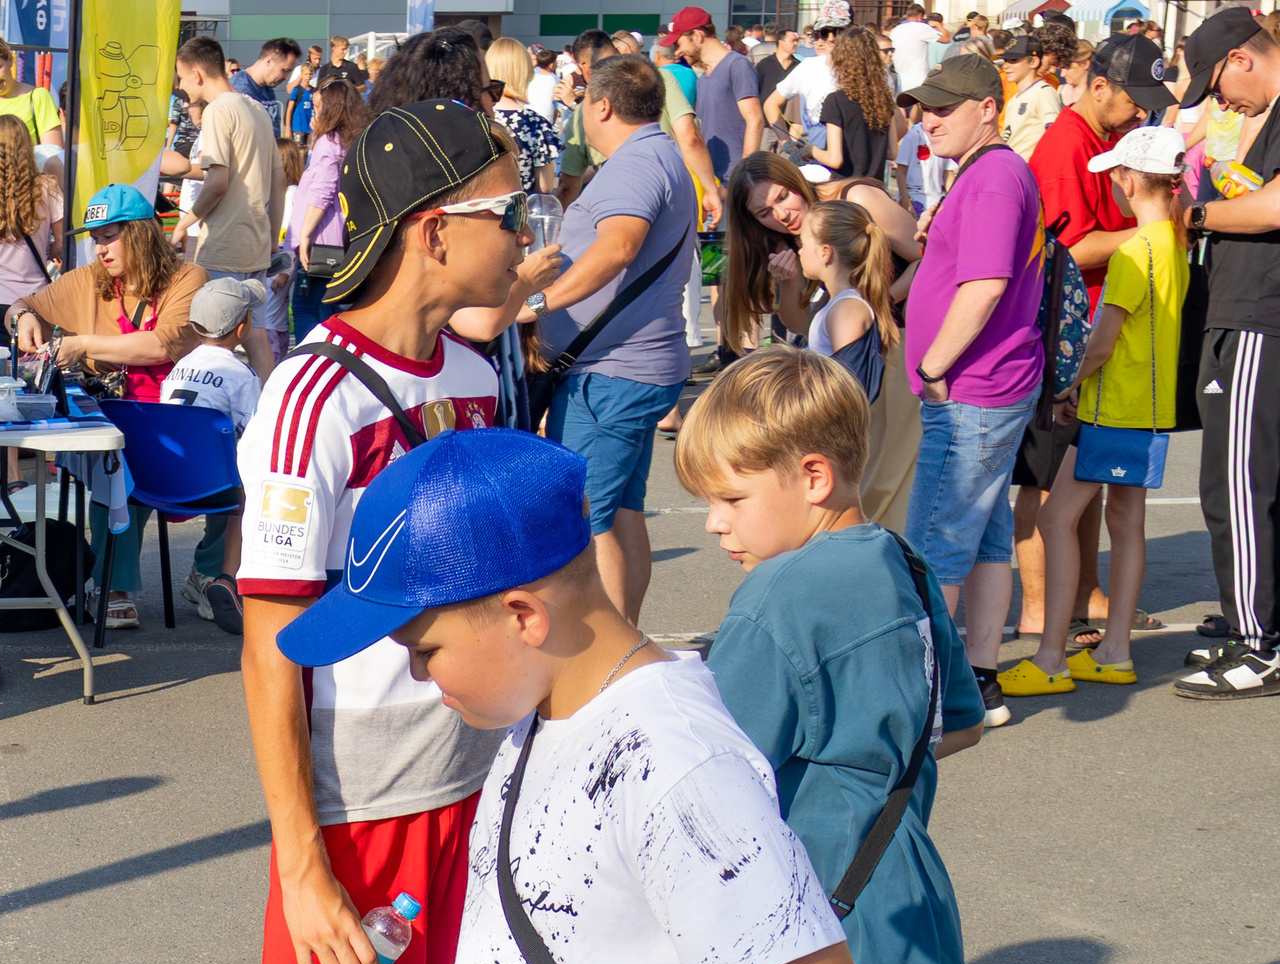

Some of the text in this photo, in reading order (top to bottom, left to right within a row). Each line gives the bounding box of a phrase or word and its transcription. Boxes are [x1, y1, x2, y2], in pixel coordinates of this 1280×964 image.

[85, 206, 107, 220] OBEY
[258, 521, 305, 538] BUNDES
[263, 533, 293, 547] LIGA
[280, 552, 302, 560] MEISTER
